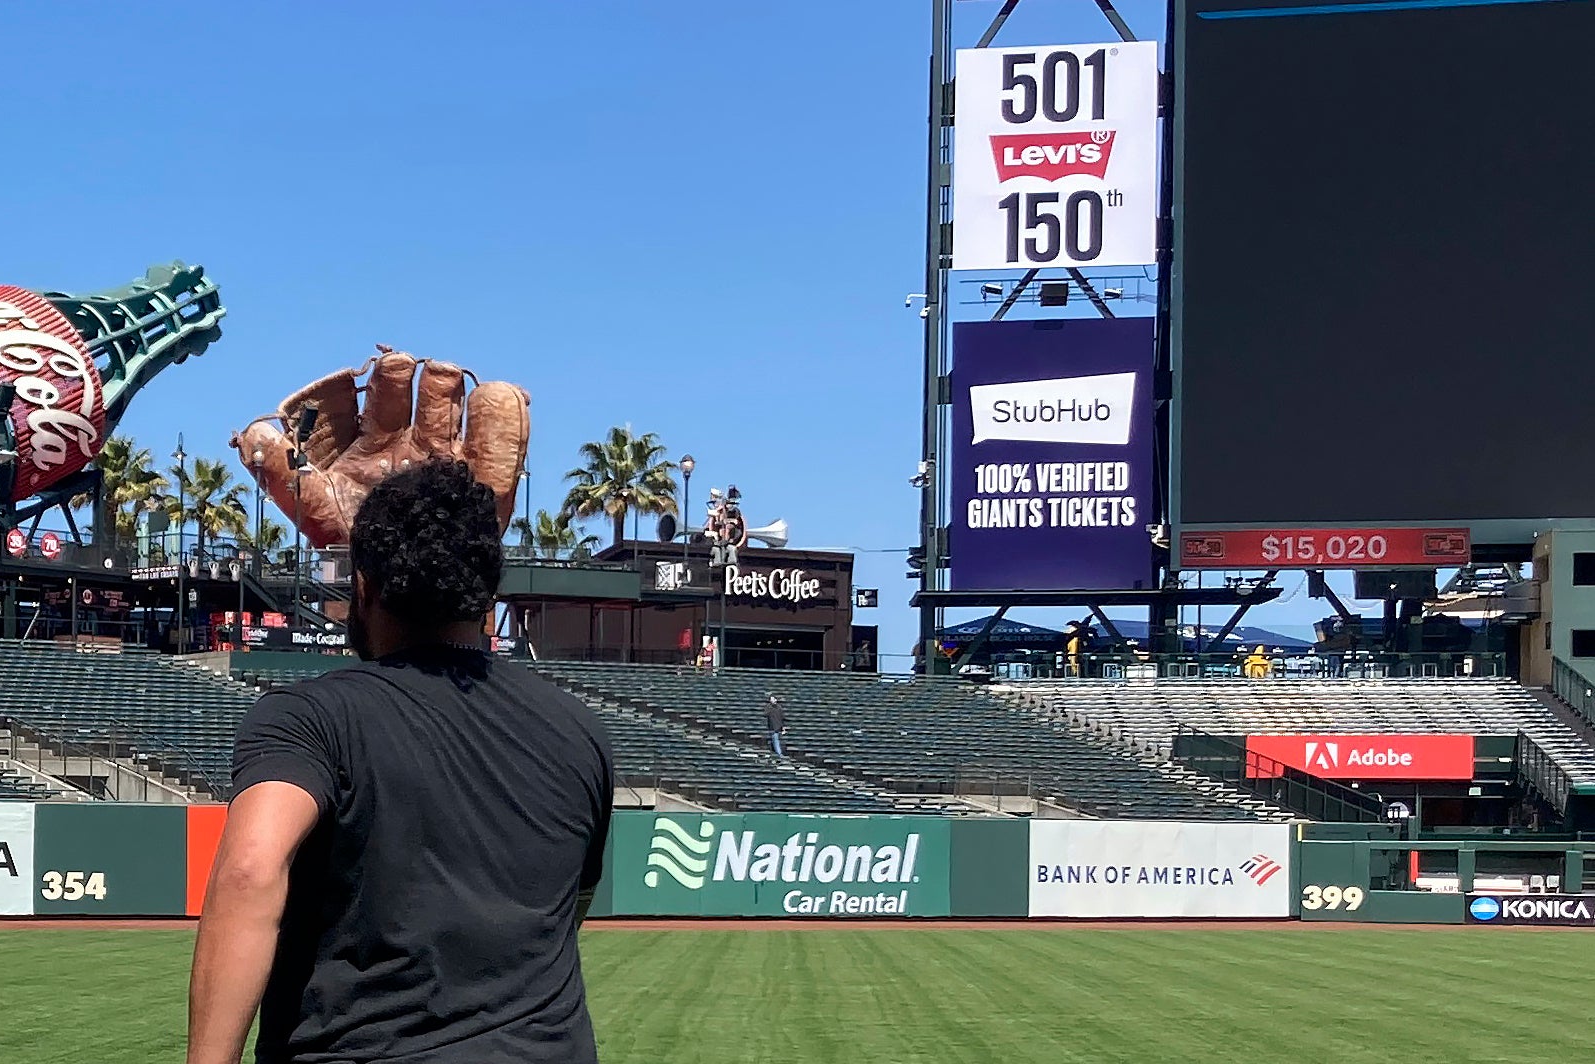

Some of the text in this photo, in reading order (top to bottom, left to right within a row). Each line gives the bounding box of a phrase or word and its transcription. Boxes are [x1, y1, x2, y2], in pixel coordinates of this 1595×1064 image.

[992, 399, 1110, 423] StubHub
[975, 462, 1129, 494] 100% VERIFIED
[967, 497, 1136, 529] GIANTS TICKETS
[1261, 534, 1387, 564] $15,020
[724, 565, 766, 599] Peet's
[769, 569, 821, 603] Coffee
[1347, 749, 1413, 766] Adobe
[712, 830, 920, 883] National
[41, 871, 106, 901] 354
[1037, 865, 1235, 886] BANK OF AMERICA
[783, 890, 908, 913] Car Rental
[1302, 885, 1365, 911] 399
[1502, 900, 1592, 919] KONICA
